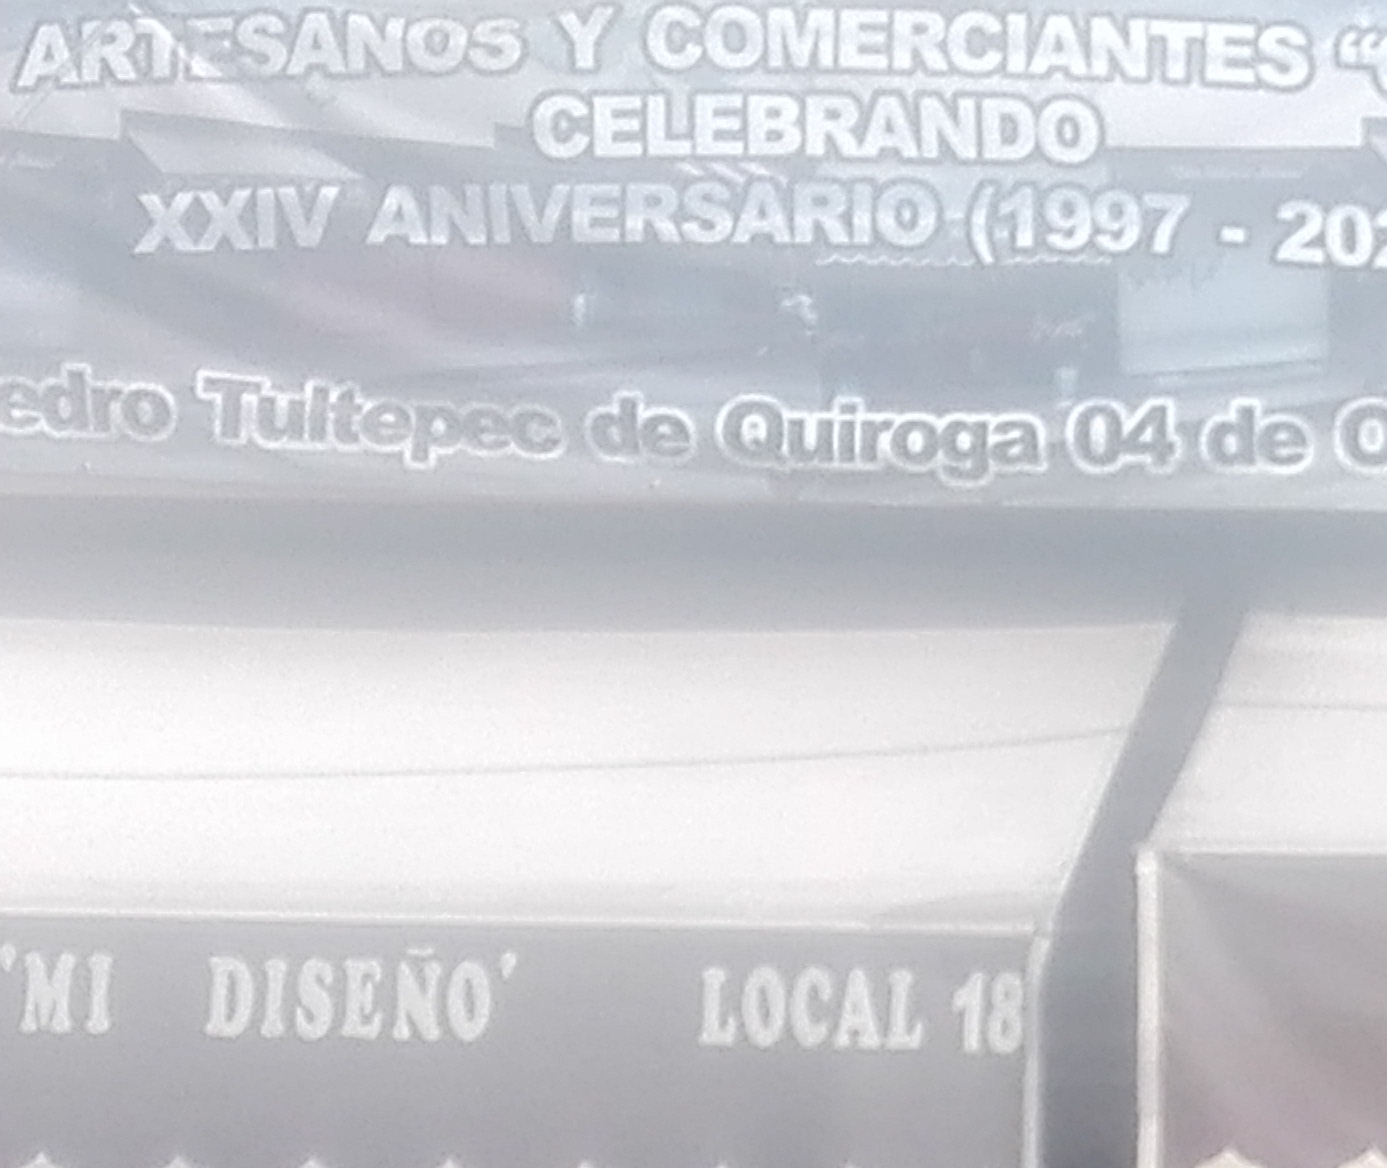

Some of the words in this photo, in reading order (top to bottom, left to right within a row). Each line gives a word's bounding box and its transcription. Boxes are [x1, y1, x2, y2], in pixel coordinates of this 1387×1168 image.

[13, 8, 524, 90] ARTESANOS
[557, 9, 607, 70] Y
[644, 4, 1310, 90] COMERCIANTES
[530, 90, 1103, 164] CELEBRANDO
[133, 182, 341, 255] XXIV
[367, 176, 941, 250] ANIVERSARIO
[966, 176, 1192, 265] (1997
[195, 368, 566, 468] Tultepec
[586, 391, 694, 464] de
[715, 393, 1048, 482] Quiroga
[1065, 398, 1179, 474] 04
[1203, 399, 1310, 473] de
[698, 967, 924, 1051] LOCAL
[952, 969, 1024, 1055] 18
